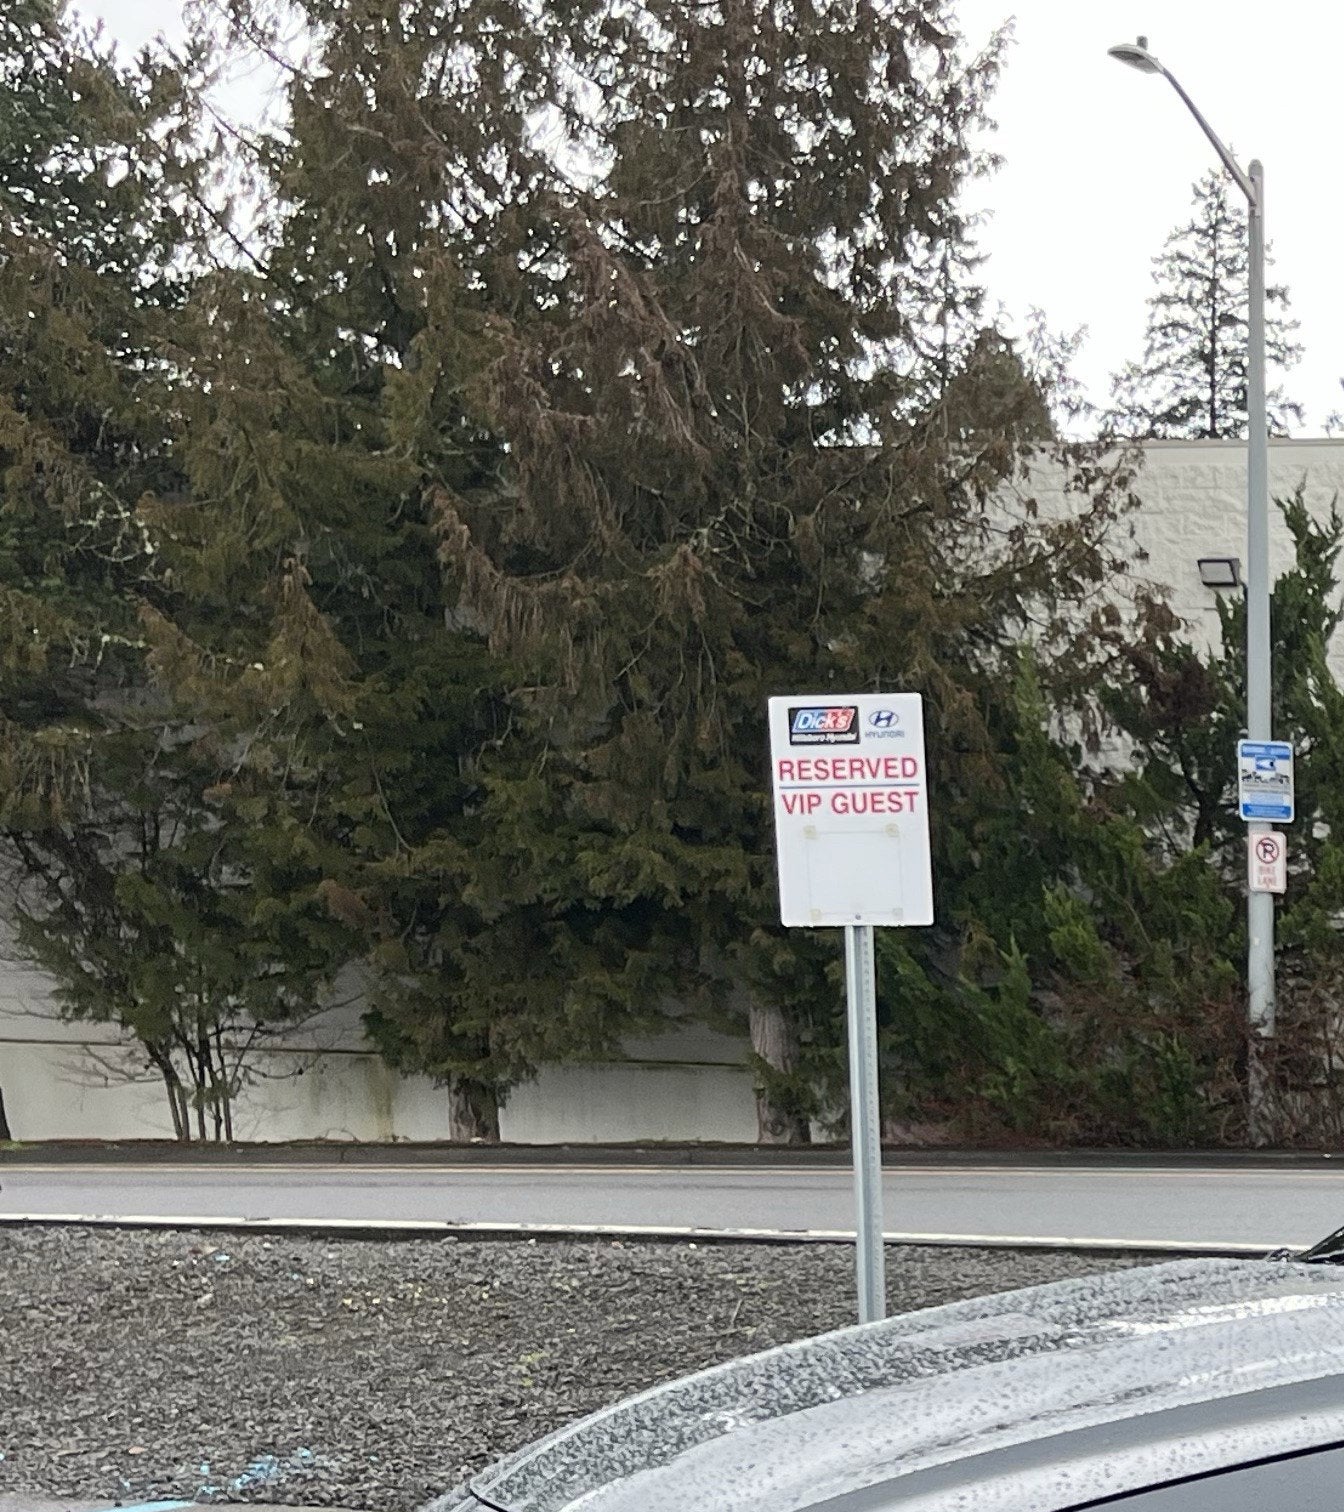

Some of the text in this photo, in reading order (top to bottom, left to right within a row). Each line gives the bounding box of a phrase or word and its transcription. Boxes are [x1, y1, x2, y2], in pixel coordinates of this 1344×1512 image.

[798, 711, 849, 730] Dick's
[864, 730, 905, 739] HYUNDAI
[779, 758, 918, 781] RESERVED
[782, 791, 919, 815] VIP GUEST
